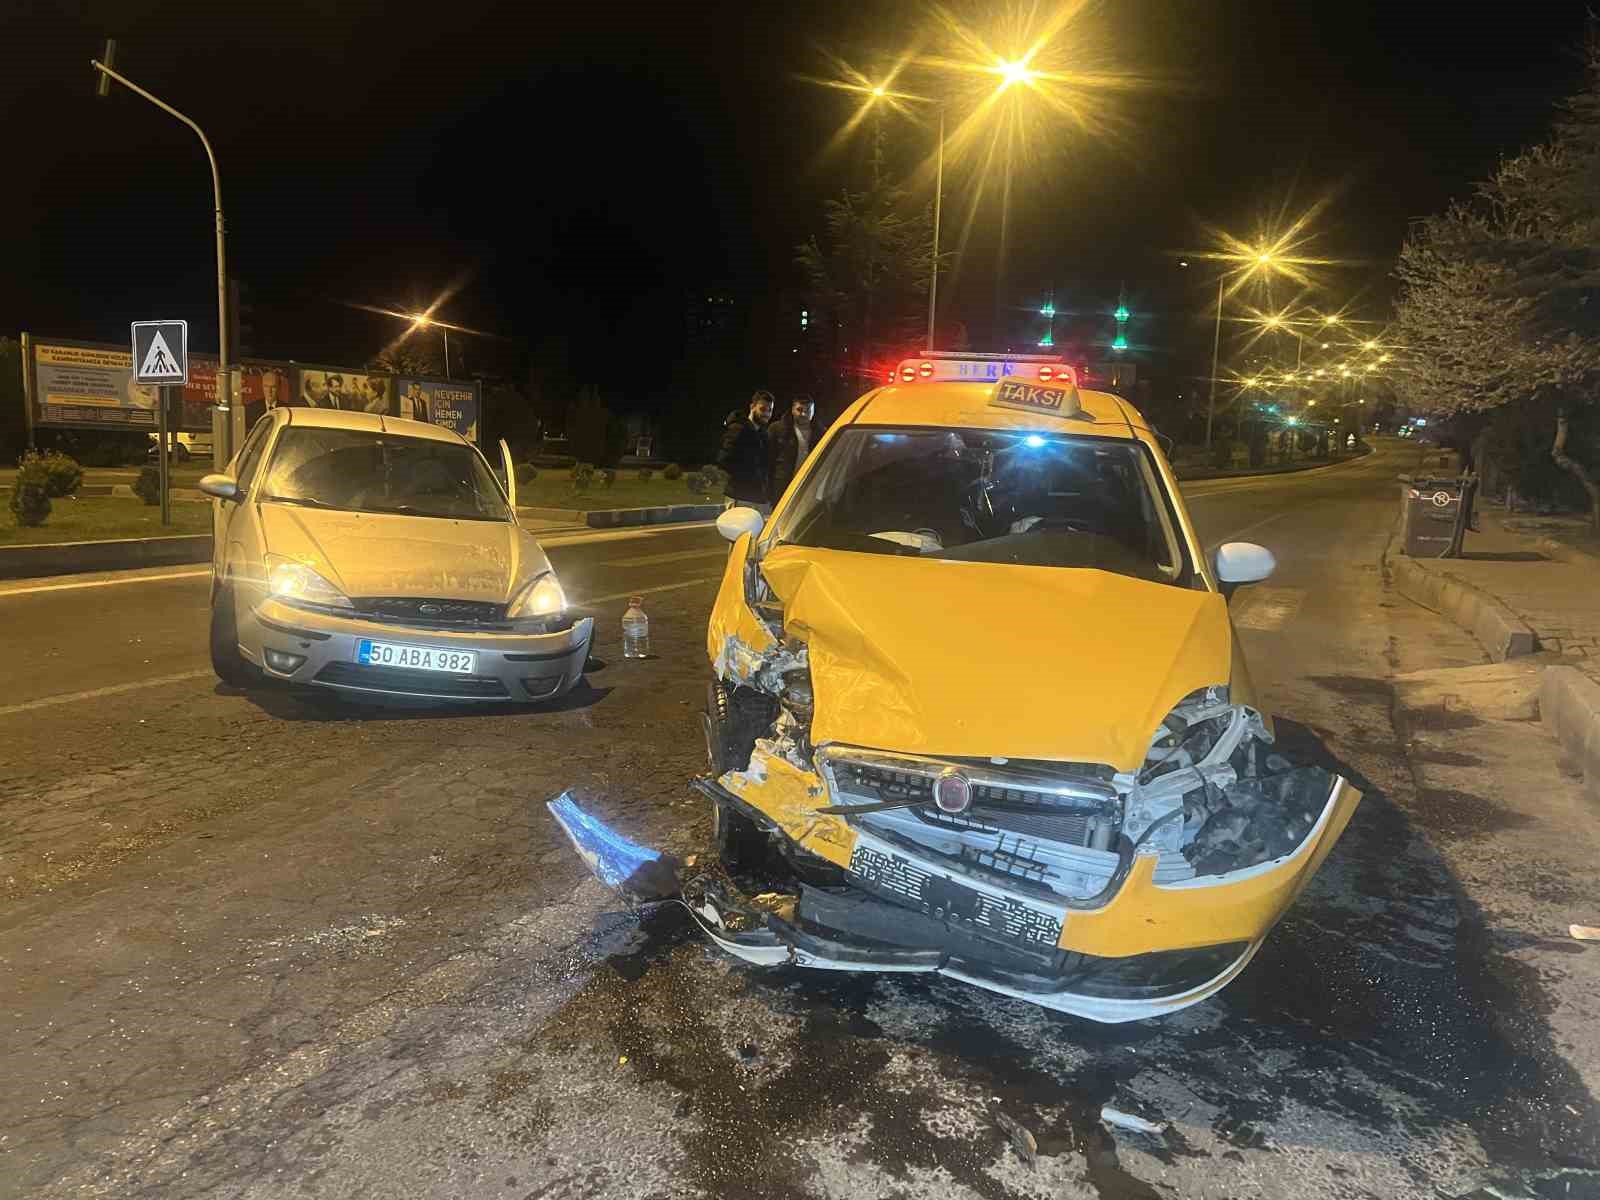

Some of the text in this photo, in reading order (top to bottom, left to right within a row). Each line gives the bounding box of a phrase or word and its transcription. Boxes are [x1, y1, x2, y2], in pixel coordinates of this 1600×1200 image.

[434, 409, 463, 420] HEMEN
[370, 646, 471, 671] 50 ABA 982
